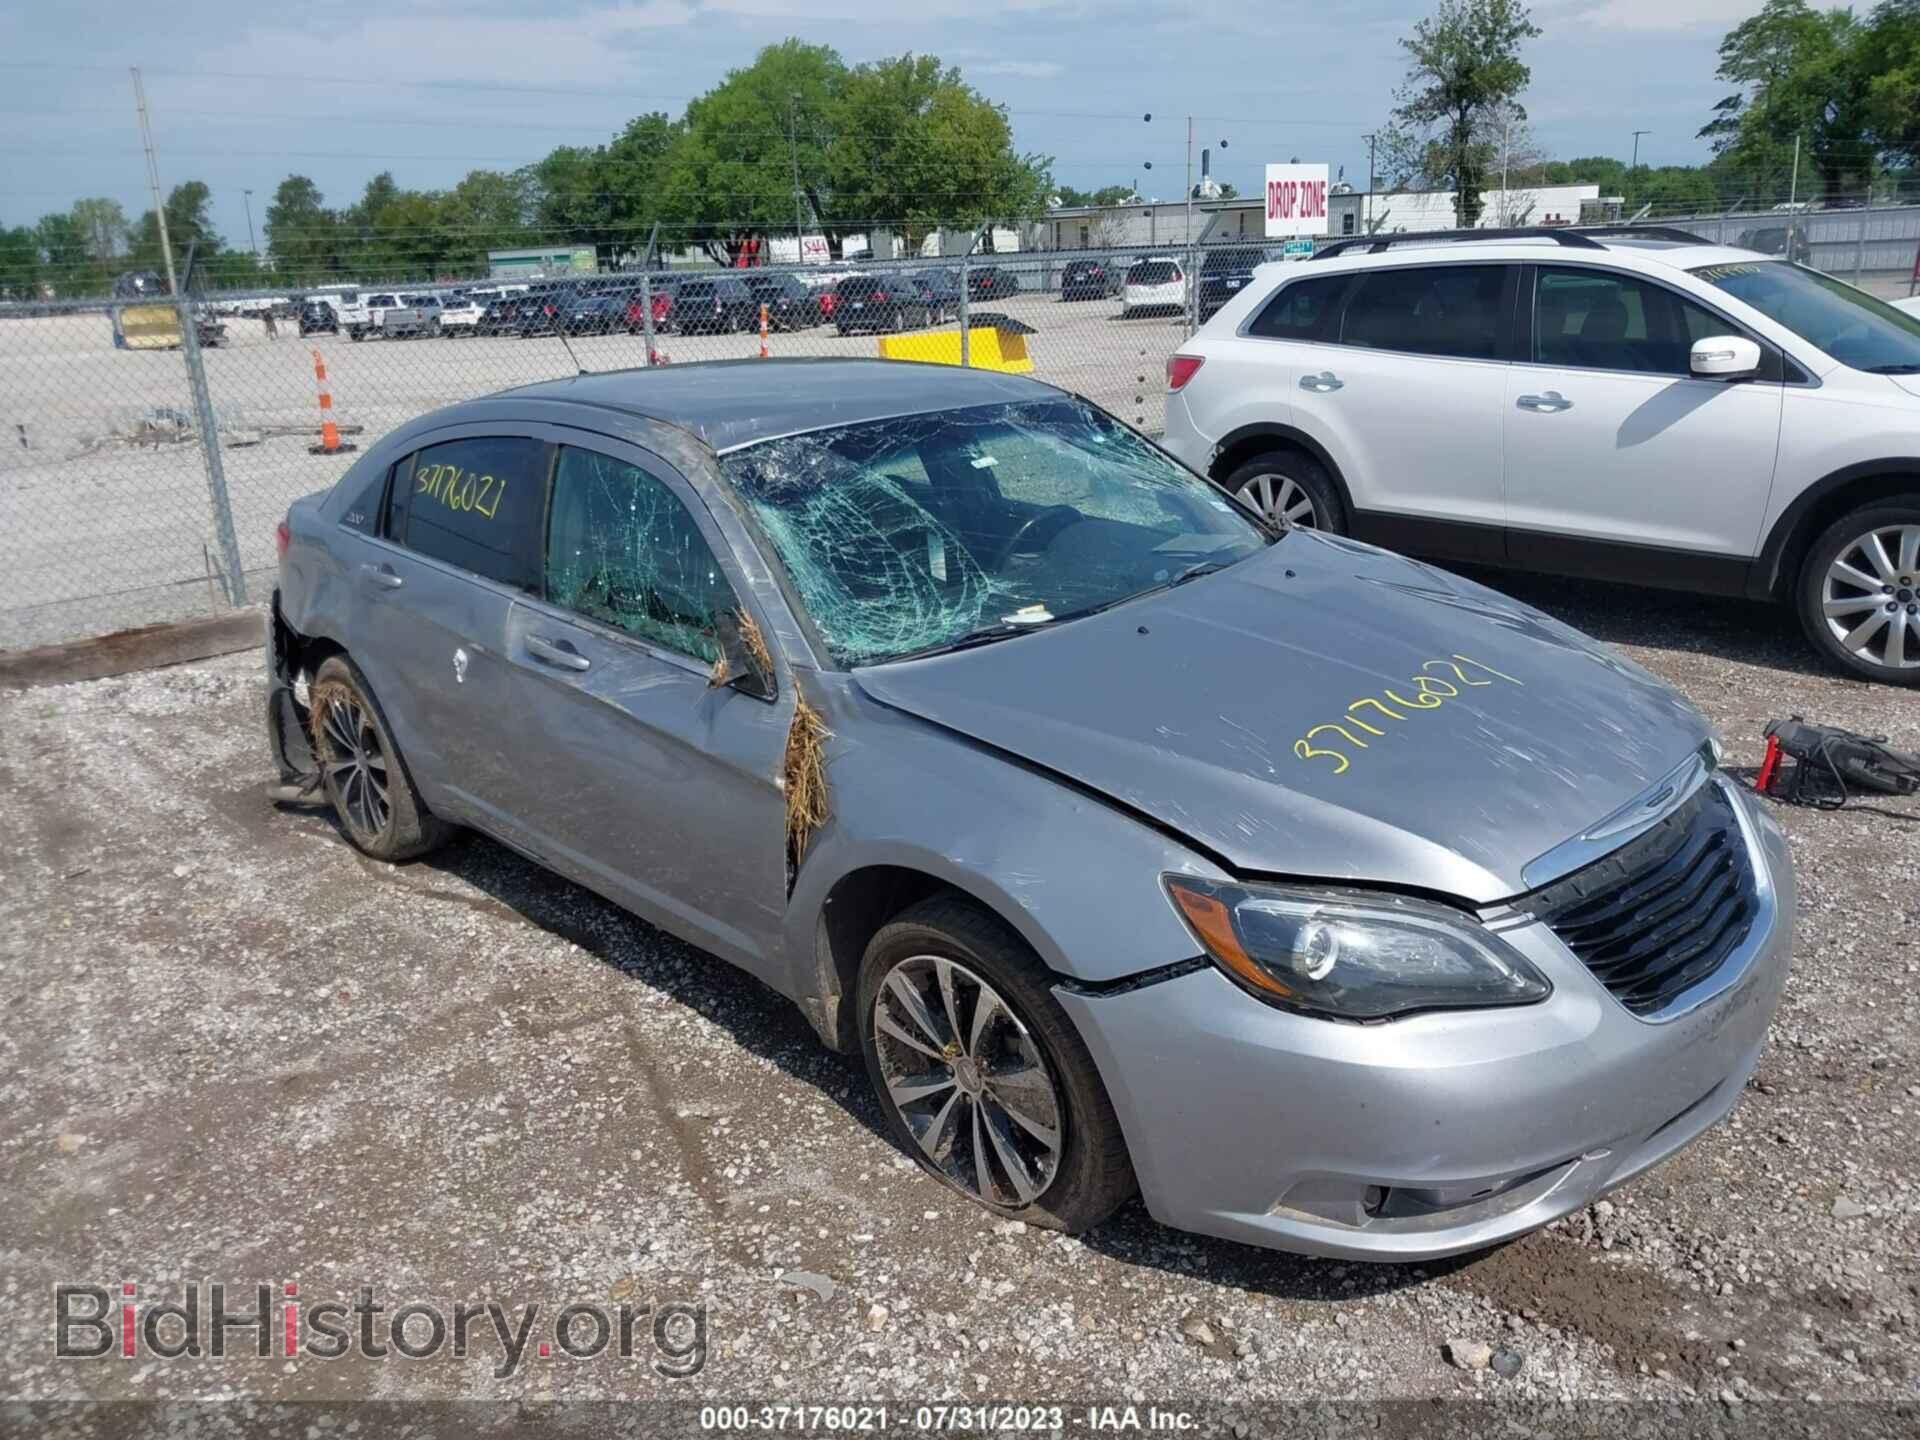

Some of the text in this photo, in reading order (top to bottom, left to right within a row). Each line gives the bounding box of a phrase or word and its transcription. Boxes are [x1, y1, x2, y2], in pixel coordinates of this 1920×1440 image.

[1268, 180, 1326, 219] DROP ZONE
[416, 464, 506, 520] 37176021
[1294, 654, 1524, 774] 37176021
